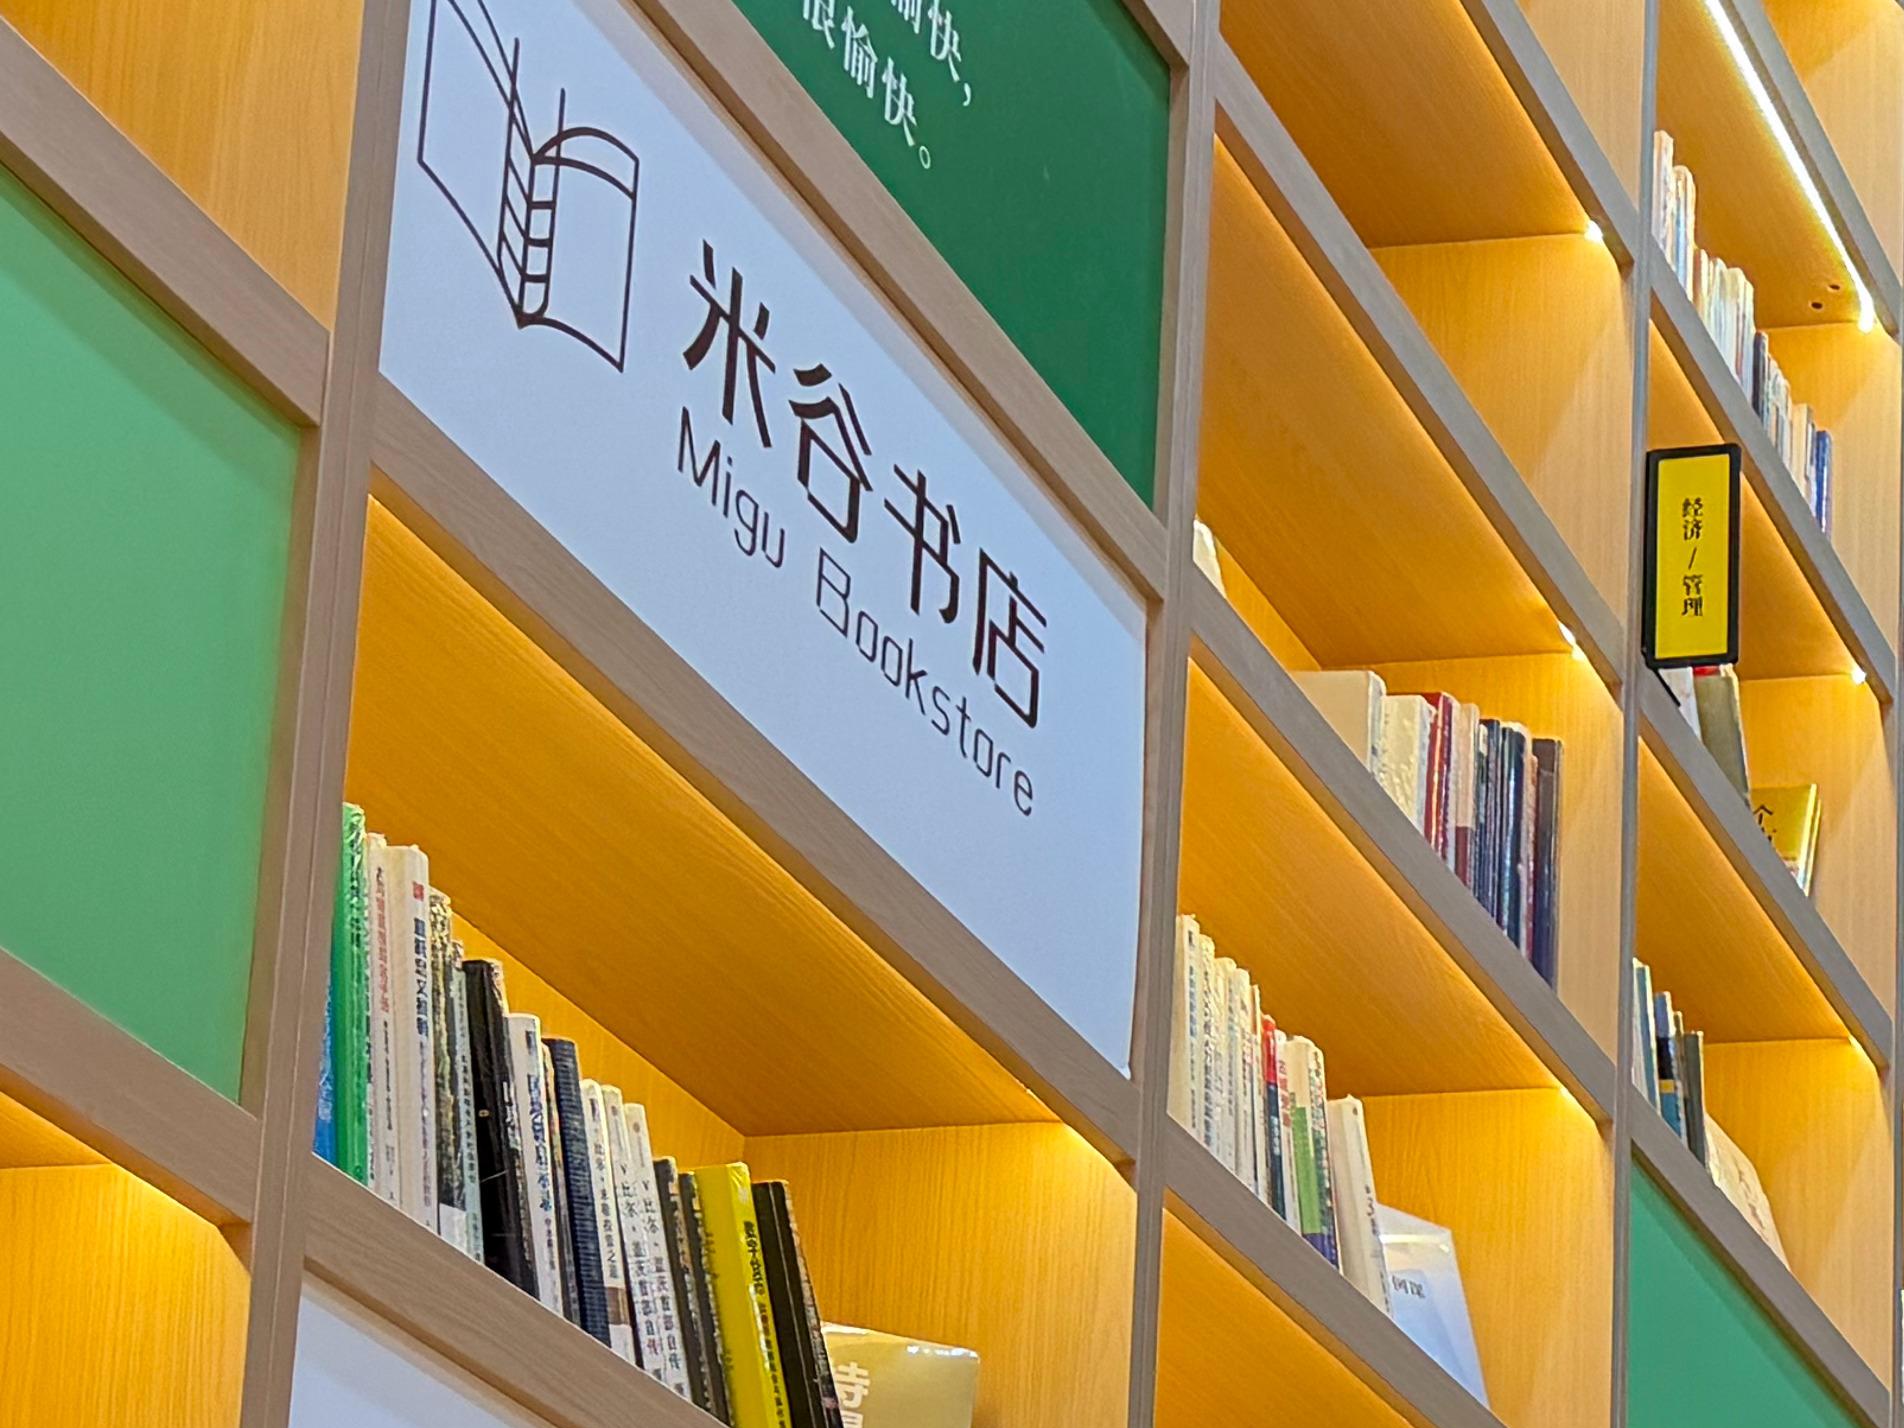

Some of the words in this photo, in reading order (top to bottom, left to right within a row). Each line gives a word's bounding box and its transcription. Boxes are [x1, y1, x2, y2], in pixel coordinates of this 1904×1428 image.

[677, 405, 787, 570] Migu
[817, 547, 1035, 818] Bookstore
[683, 239, 1046, 730] 米谷书店
